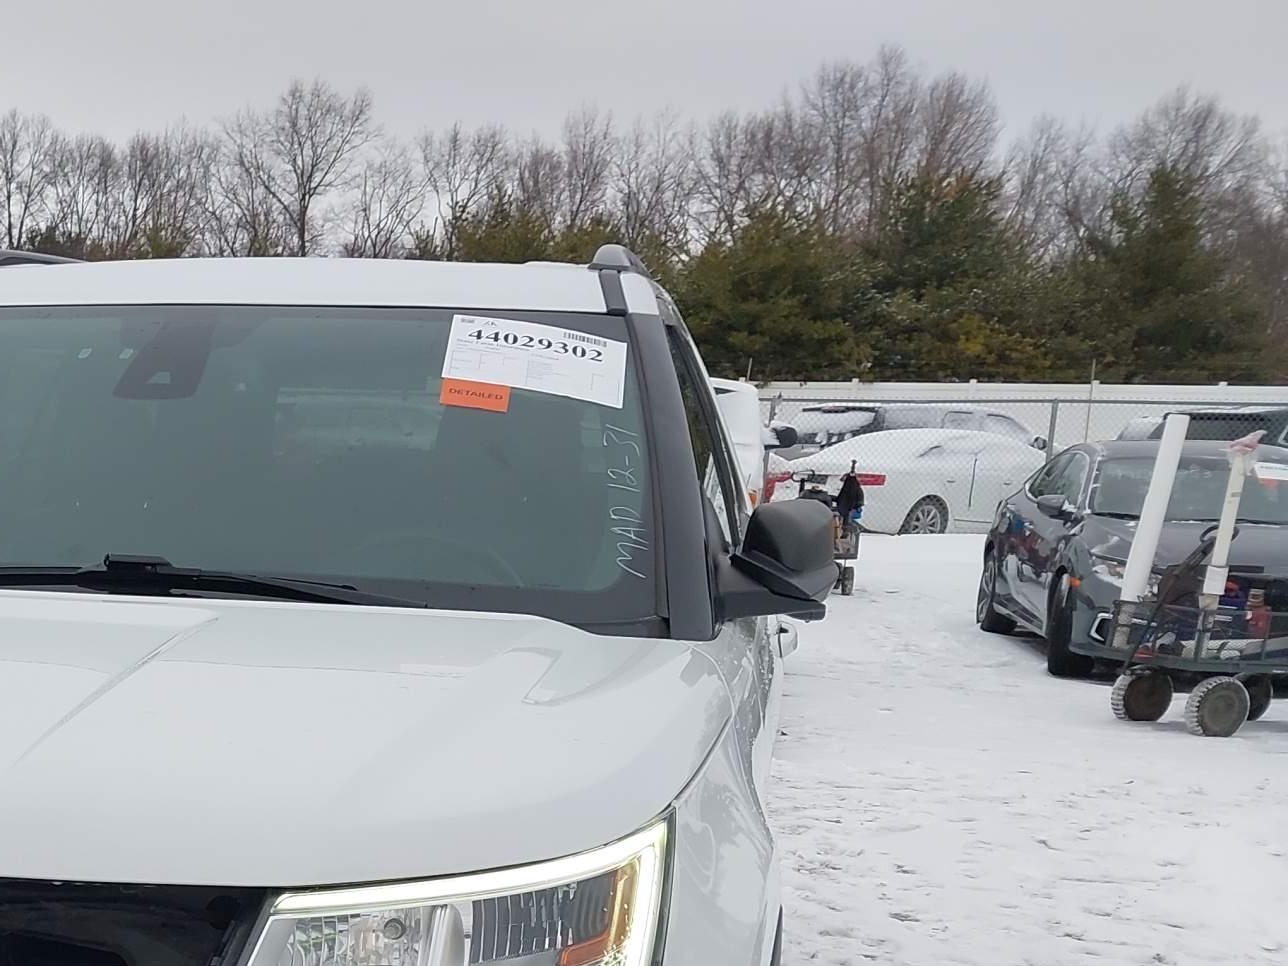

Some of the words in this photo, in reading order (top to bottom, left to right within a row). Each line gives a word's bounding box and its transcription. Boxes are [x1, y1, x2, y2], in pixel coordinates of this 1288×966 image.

[468, 328, 604, 362] 44029302
[448, 387, 504, 400] DETAILED
[603, 423, 641, 492] 12-31
[609, 506, 649, 579] MAD
